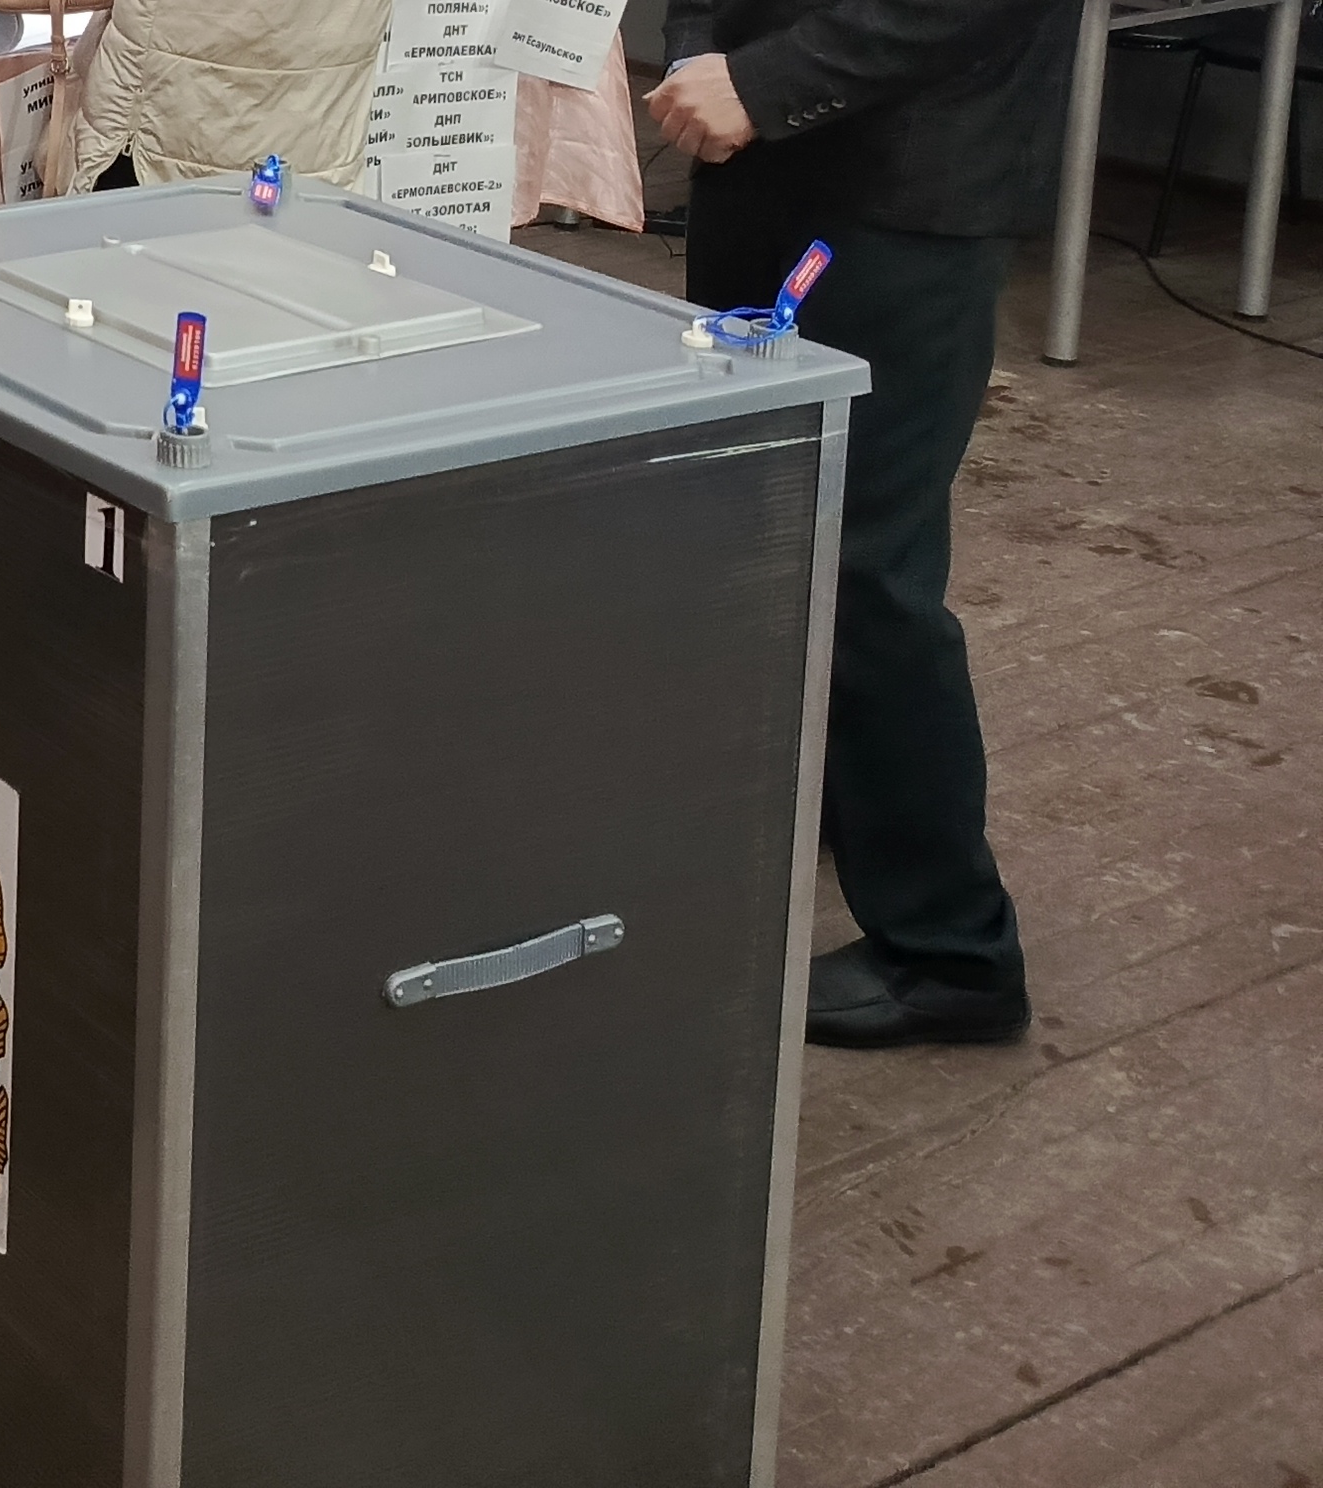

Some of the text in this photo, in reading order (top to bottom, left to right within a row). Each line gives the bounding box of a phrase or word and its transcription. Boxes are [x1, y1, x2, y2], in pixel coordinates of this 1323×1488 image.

[427, 1, 489, 15] ПОЛЯНА»;
[443, 24, 468, 39] ДНТ
[404, 44, 497, 59] «ЕРМОЛАЕВКА
[526, 35, 583, 63] Есаульское
[439, 70, 464, 83] ТСН
[22, 75, 55, 98] улиц
[412, 88, 507, 105] АРИПОВСКОЕ»;
[434, 113, 462, 128] ДНП
[406, 131, 495, 149] БОЛЬШЕВИК»;
[432, 161, 458, 176] ДНТ
[391, 179, 503, 200] «ЕРМОЛАЕВСКОЕ-2»
[425, 201, 491, 218] «ЗОЛОТАЯ
